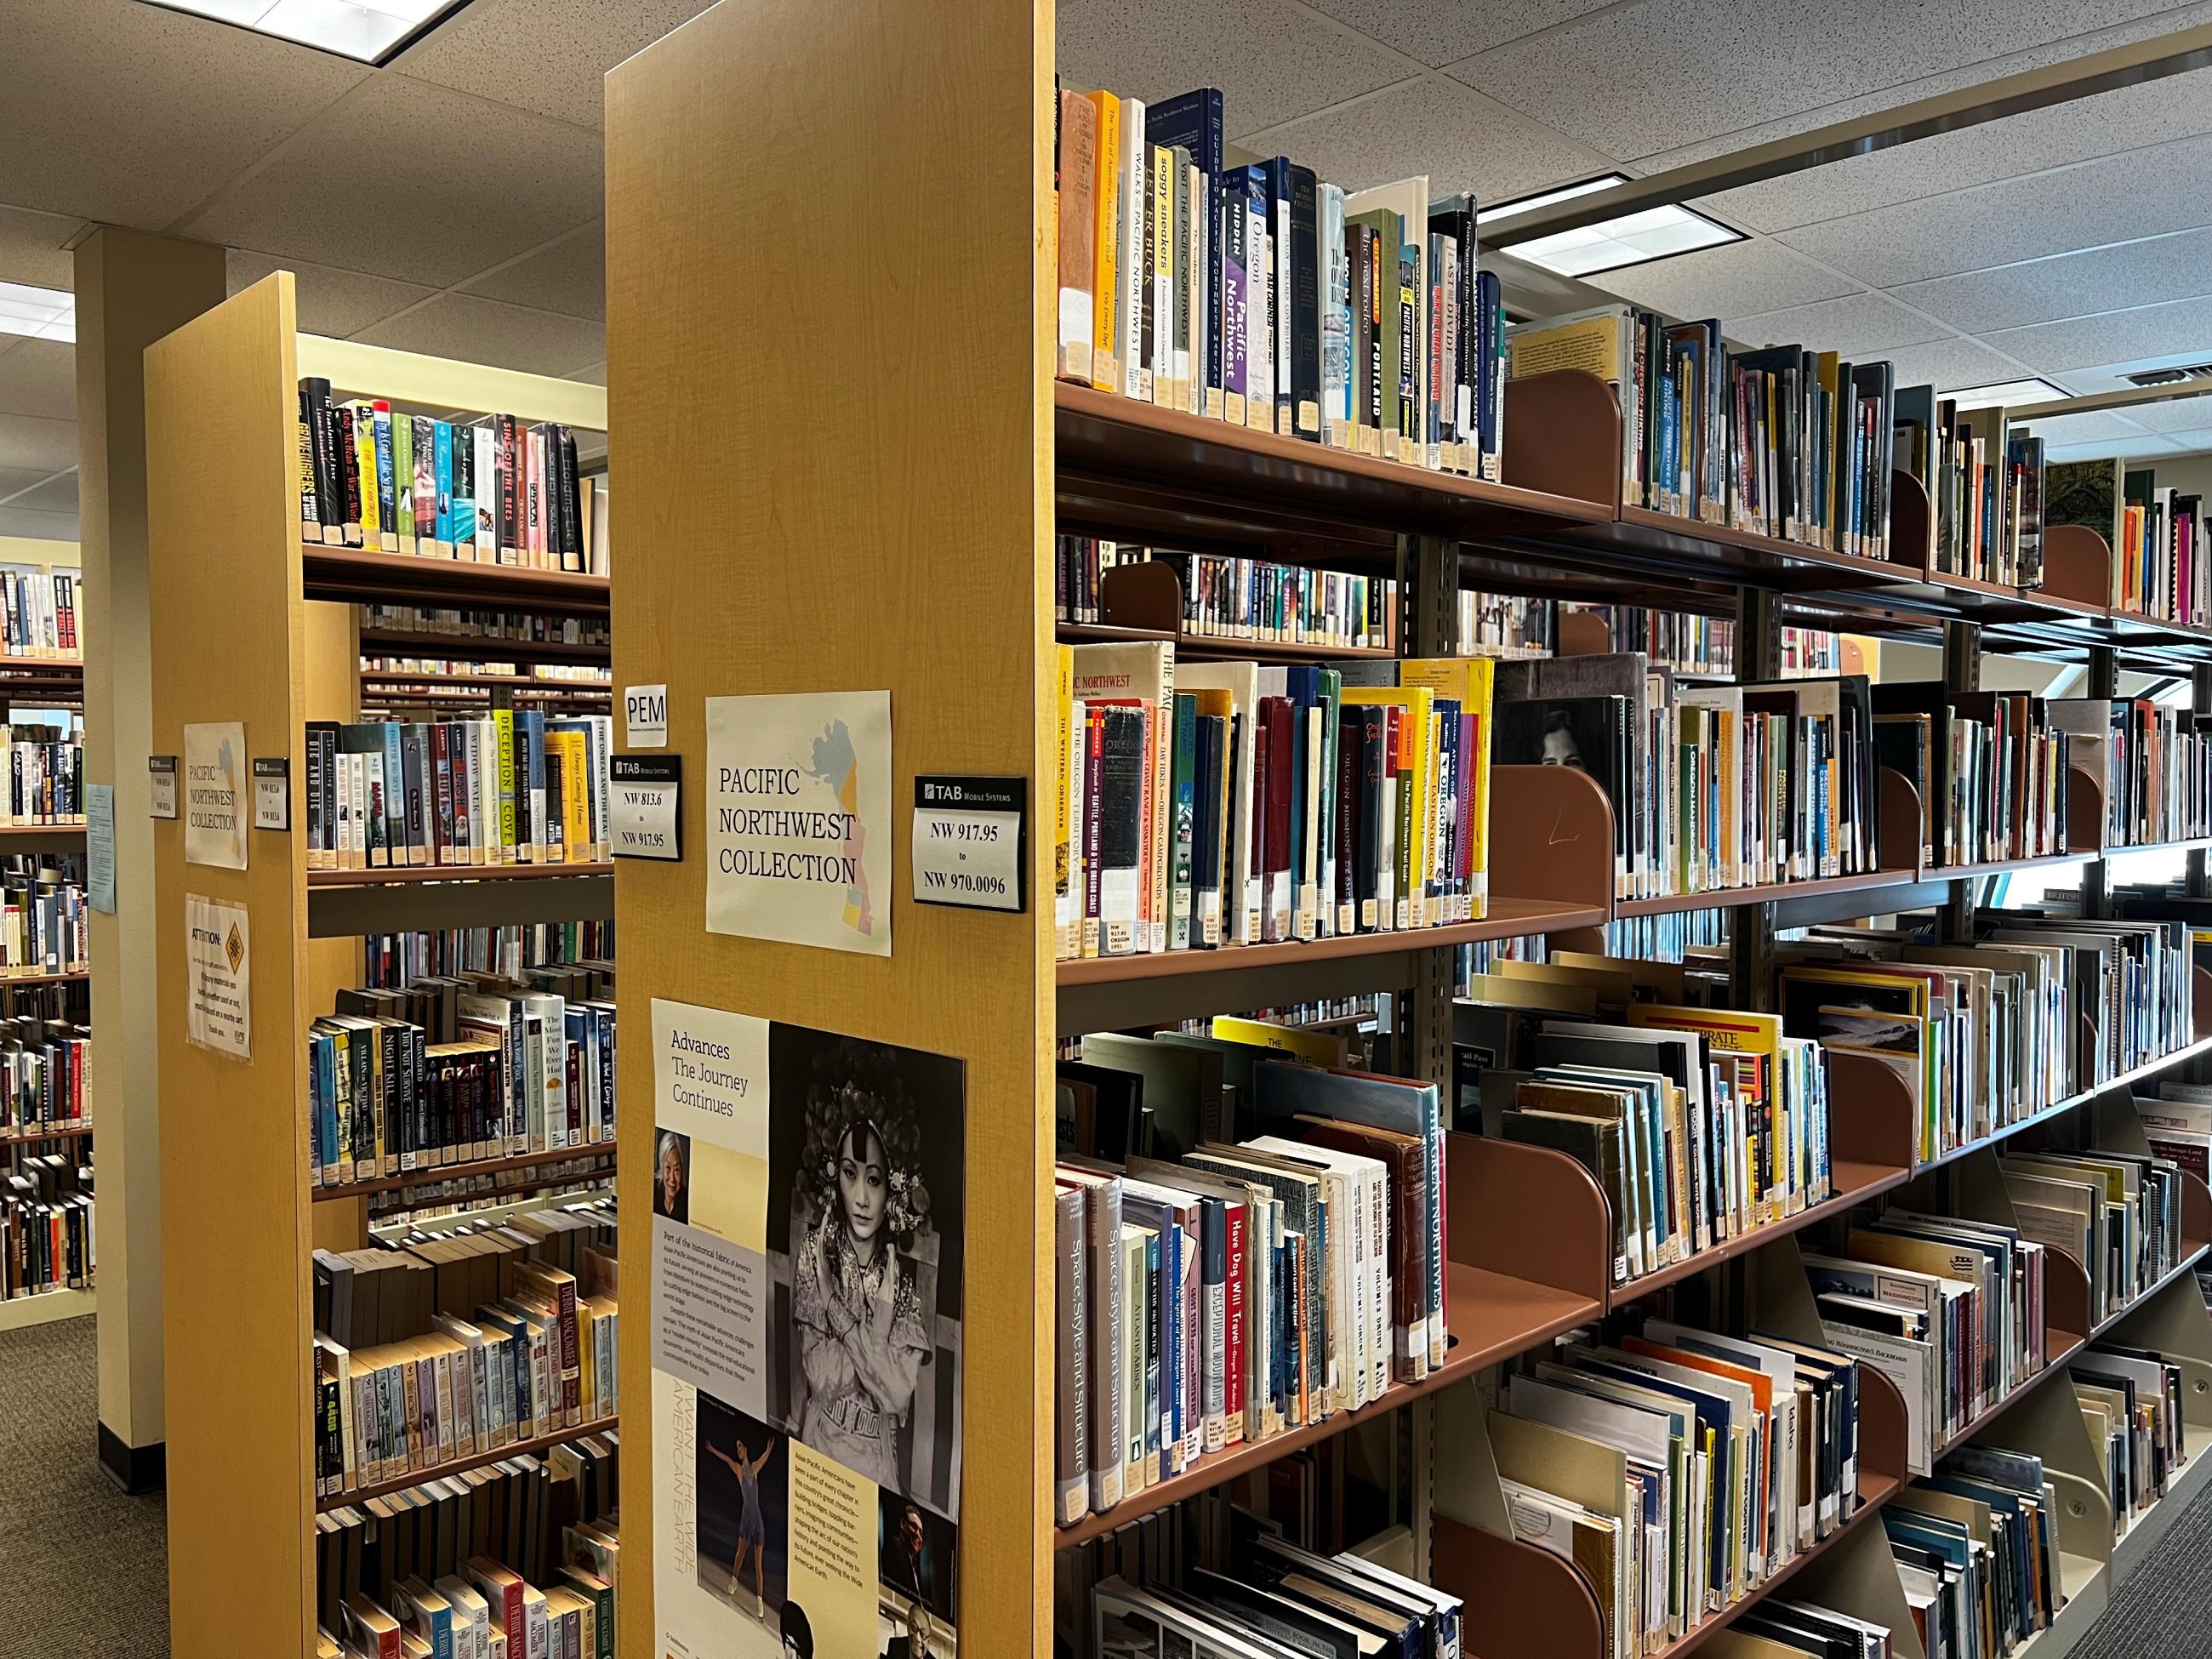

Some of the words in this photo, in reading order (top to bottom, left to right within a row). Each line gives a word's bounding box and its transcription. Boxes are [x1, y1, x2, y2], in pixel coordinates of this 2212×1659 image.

[1159, 157, 1167, 201] soggy
[1160, 202, 1169, 269] sneakers
[1251, 221, 1263, 283] Oregon
[1132, 265, 1140, 352] NORTHWEST
[1362, 294, 1371, 334] rodeo
[1226, 278, 1237, 379] Northwest
[1236, 300, 1246, 362] Pacific
[1445, 303, 1455, 356] DIVIDE
[1402, 335, 1411, 374] NORTHWEST
[342, 410, 352, 430] Andy
[299, 422, 315, 493] GRAVEDIGGERS
[345, 432, 354, 464] McBean
[504, 453, 511, 467] OF
[382, 461, 391, 475] Lake
[562, 459, 573, 512] Holding
[565, 520, 576, 546] Lies
[1082, 674, 1131, 689] NORTHWEST
[1164, 653, 1173, 678] THE
[627, 695, 664, 723] PEM
[501, 716, 511, 788] DECEPTION
[623, 762, 640, 774] TAB
[190, 765, 215, 781] PACIFIC
[310, 766, 320, 785] AND
[720, 768, 800, 795] PACIFIC
[191, 789, 236, 807] NORTHWEST
[311, 792, 320, 809] DIE
[624, 792, 639, 805] NW
[641, 792, 662, 807] 813.6
[936, 785, 962, 801] TAB
[191, 812, 237, 830] COLLECTION
[504, 805, 513, 839] COVE
[720, 809, 856, 841] NORTHWEST
[931, 823, 956, 839] NW
[957, 824, 998, 841] 917.95
[1157, 801, 1166, 835] OREGON
[622, 831, 636, 846] NW
[638, 832, 664, 847] 917.95
[720, 848, 856, 884] COLLECTION
[960, 852, 966, 861] to
[1156, 837, 1165, 899] CAMPGROUNDS
[924, 871, 947, 888] NW
[950, 873, 1006, 894] 970.0096
[385, 1035, 395, 1069] NIGHT
[402, 1050, 411, 1066] NOT
[672, 1031, 730, 1060] Advances
[1267, 1036, 1283, 1048] THE
[386, 1073, 395, 1095] KILL
[402, 1069, 411, 1103] SURVIVE
[673, 1056, 695, 1080] The
[698, 1061, 748, 1097] Journey
[673, 1084, 733, 1118] Continues
[1429, 1109, 1438, 1142] THE
[1430, 1146, 1440, 1202] GREAT
[1232, 1220, 1241, 1249] Have
[1071, 1240, 1083, 1302] Space,
[1108, 1229, 1119, 1290] Space,
[1230, 1252, 1241, 1277] Dog
[562, 1286, 573, 1315] DEBBIE
[1232, 1280, 1241, 1305] Will
[1882, 1290, 1924, 1303] WASHINGTON
[1071, 1304, 1083, 1349] Style
[1108, 1291, 1120, 1336] Style
[1212, 1286, 1223, 1349] EXCEPTIONAL
[563, 1319, 575, 1367] MACOMBER
[1111, 1342, 1120, 1376] and
[1074, 1353, 1084, 1387] and
[1211, 1352, 1223, 1406] MOUNTAINS
[673, 1379, 683, 1497] AMERICAN
[685, 1398, 694, 1459] WANT
[1074, 1391, 1084, 1472] Structure
[1111, 1382, 1120, 1460] Structure
[685, 1473, 694, 1513] THE
[673, 1499, 684, 1574] EARTH
[685, 1520, 695, 1576] WIDE
[510, 1604, 520, 1633] DEBBIE
[438, 1628, 448, 1658] DEBBIE
